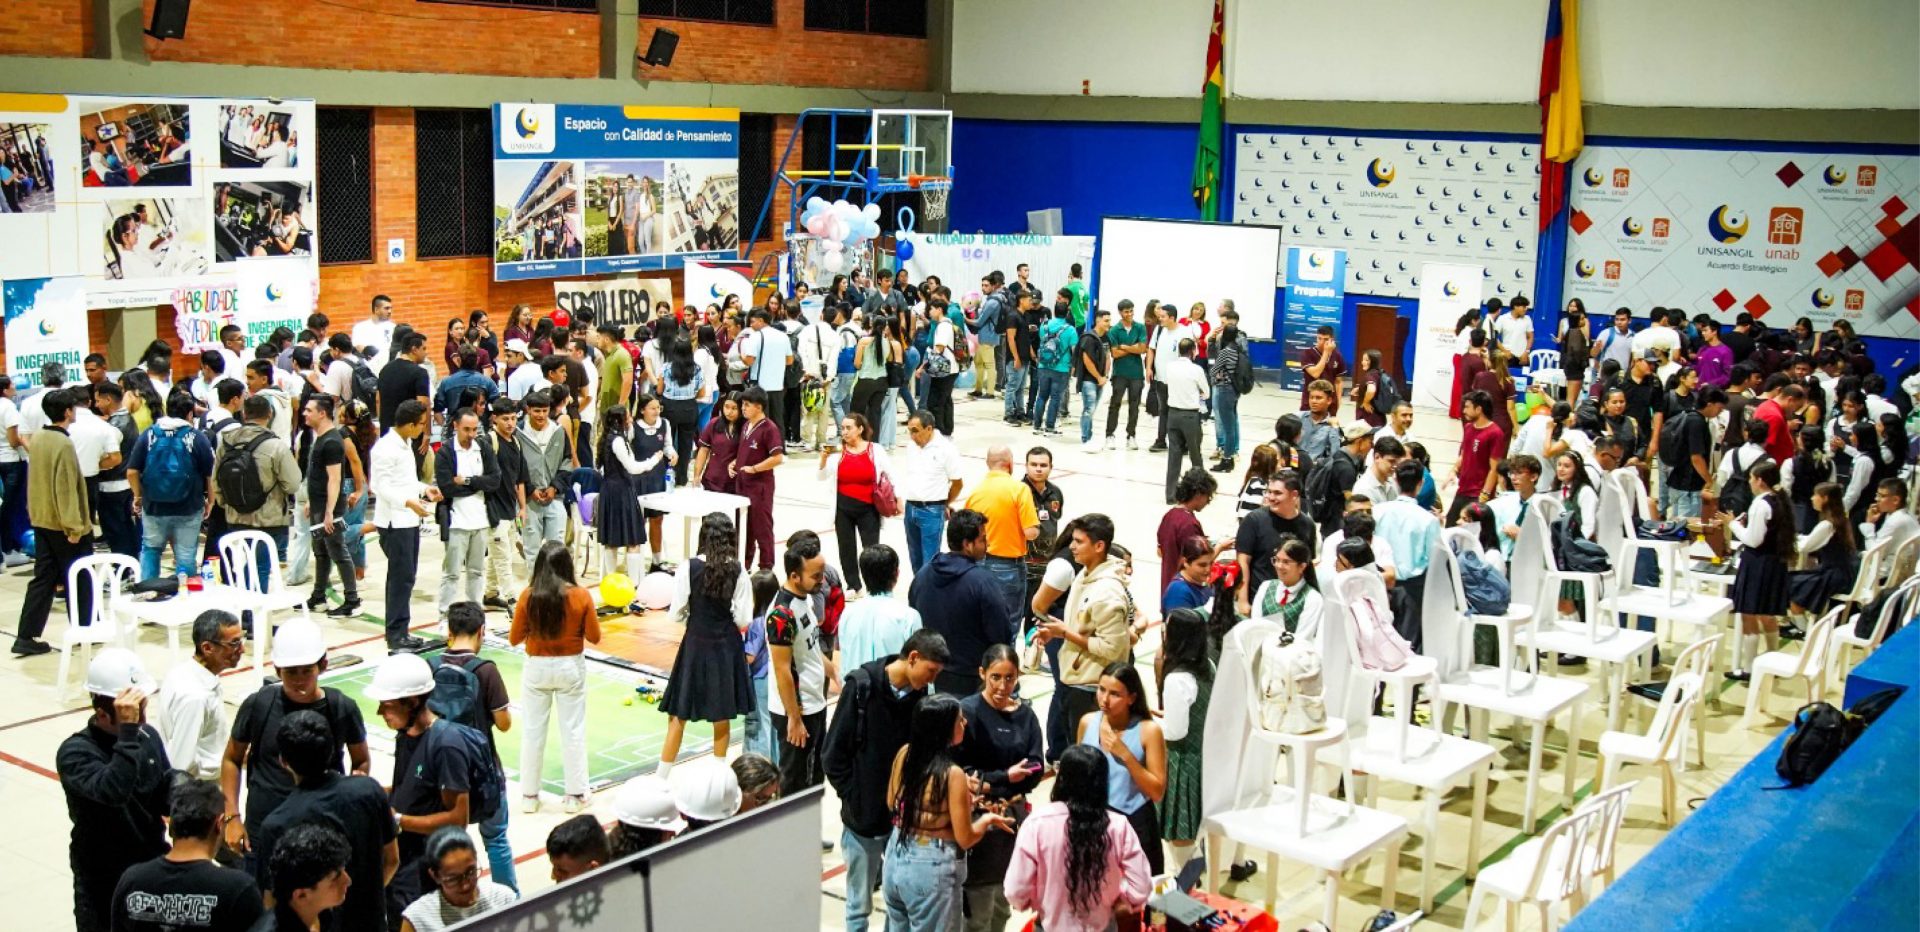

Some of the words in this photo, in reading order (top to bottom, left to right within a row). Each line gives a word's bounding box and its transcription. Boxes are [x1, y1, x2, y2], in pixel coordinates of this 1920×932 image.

[564, 117, 607, 132] Espacio
[604, 132, 620, 141] con
[622, 128, 663, 142] Calidad
[665, 132, 675, 141] de
[676, 130, 732, 143] Pensamiento
[961, 248, 991, 260] UCI
[1697, 247, 1754, 258] UNISANGIL
[1765, 248, 1800, 260] unab
[1707, 261, 1740, 270] Acuerdo
